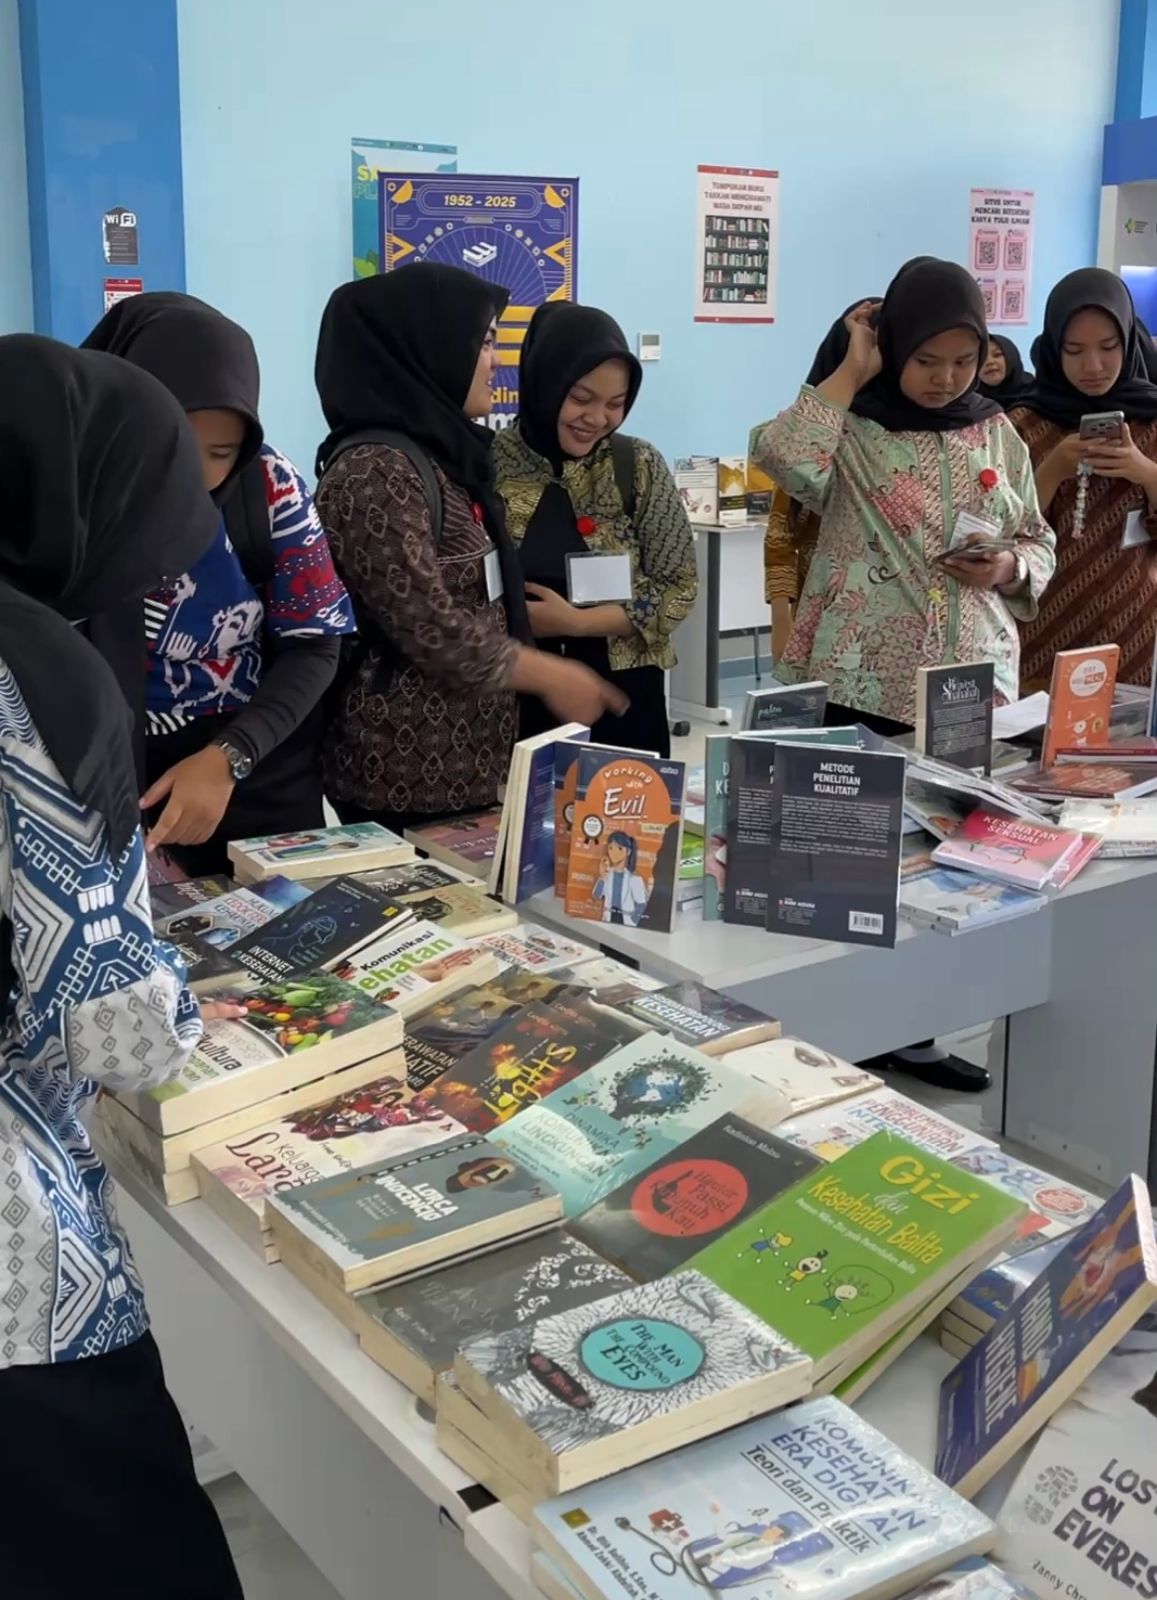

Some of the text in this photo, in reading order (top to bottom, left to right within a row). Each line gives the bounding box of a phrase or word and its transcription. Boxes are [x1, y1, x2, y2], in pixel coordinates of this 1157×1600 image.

[444, 195, 473, 207] 1952
[485, 195, 517, 208] 2025
[813, 772, 860, 786] PENELITIAN
[820, 762, 855, 774] METODE
[604, 787, 645, 816] Evil
[813, 784, 859, 796] KUALITATIF
[983, 815, 1058, 841] KESEHATAN
[987, 825, 1042, 845] SEKSUAL
[238, 950, 286, 983] KESEHATAN
[248, 945, 295, 973] INTERNET
[358, 938, 454, 990] ehatan
[360, 930, 435, 971] Komunikasi
[633, 996, 722, 1038] KESEHATAN
[404, 1034, 459, 1068] ERAWATAN
[564, 1113, 621, 1149] DINAMIKA
[864, 1099, 965, 1154] PENGGUNAAN
[521, 1122, 609, 1177] LINGKUNGAN
[375, 1175, 443, 1222] INOCENCIO
[412, 1182, 460, 1217] LORCA
[879, 1155, 980, 1216] Gizi
[807, 1175, 944, 1265] Kesehatan Balita
[1020, 1282, 1051, 1360] HAND
[598, 1344, 650, 1382] EYES
[603, 1328, 627, 1343] THE
[621, 1344, 673, 1385] COMPOUND
[627, 1322, 687, 1368] THE MAN
[632, 1341, 663, 1363] WITH
[985, 1320, 1017, 1436] HYGIENE
[768, 1433, 822, 1469] ERA
[811, 1415, 951, 1520] KOMUNIK
[741, 1444, 791, 1478] Teori
[779, 1476, 820, 1503] dan
[1098, 1458, 1157, 1516] LOS
[1081, 1485, 1125, 1525] ON
[1053, 1508, 1157, 1600] EVERES
[1032, 1560, 1064, 1590] Vanny
